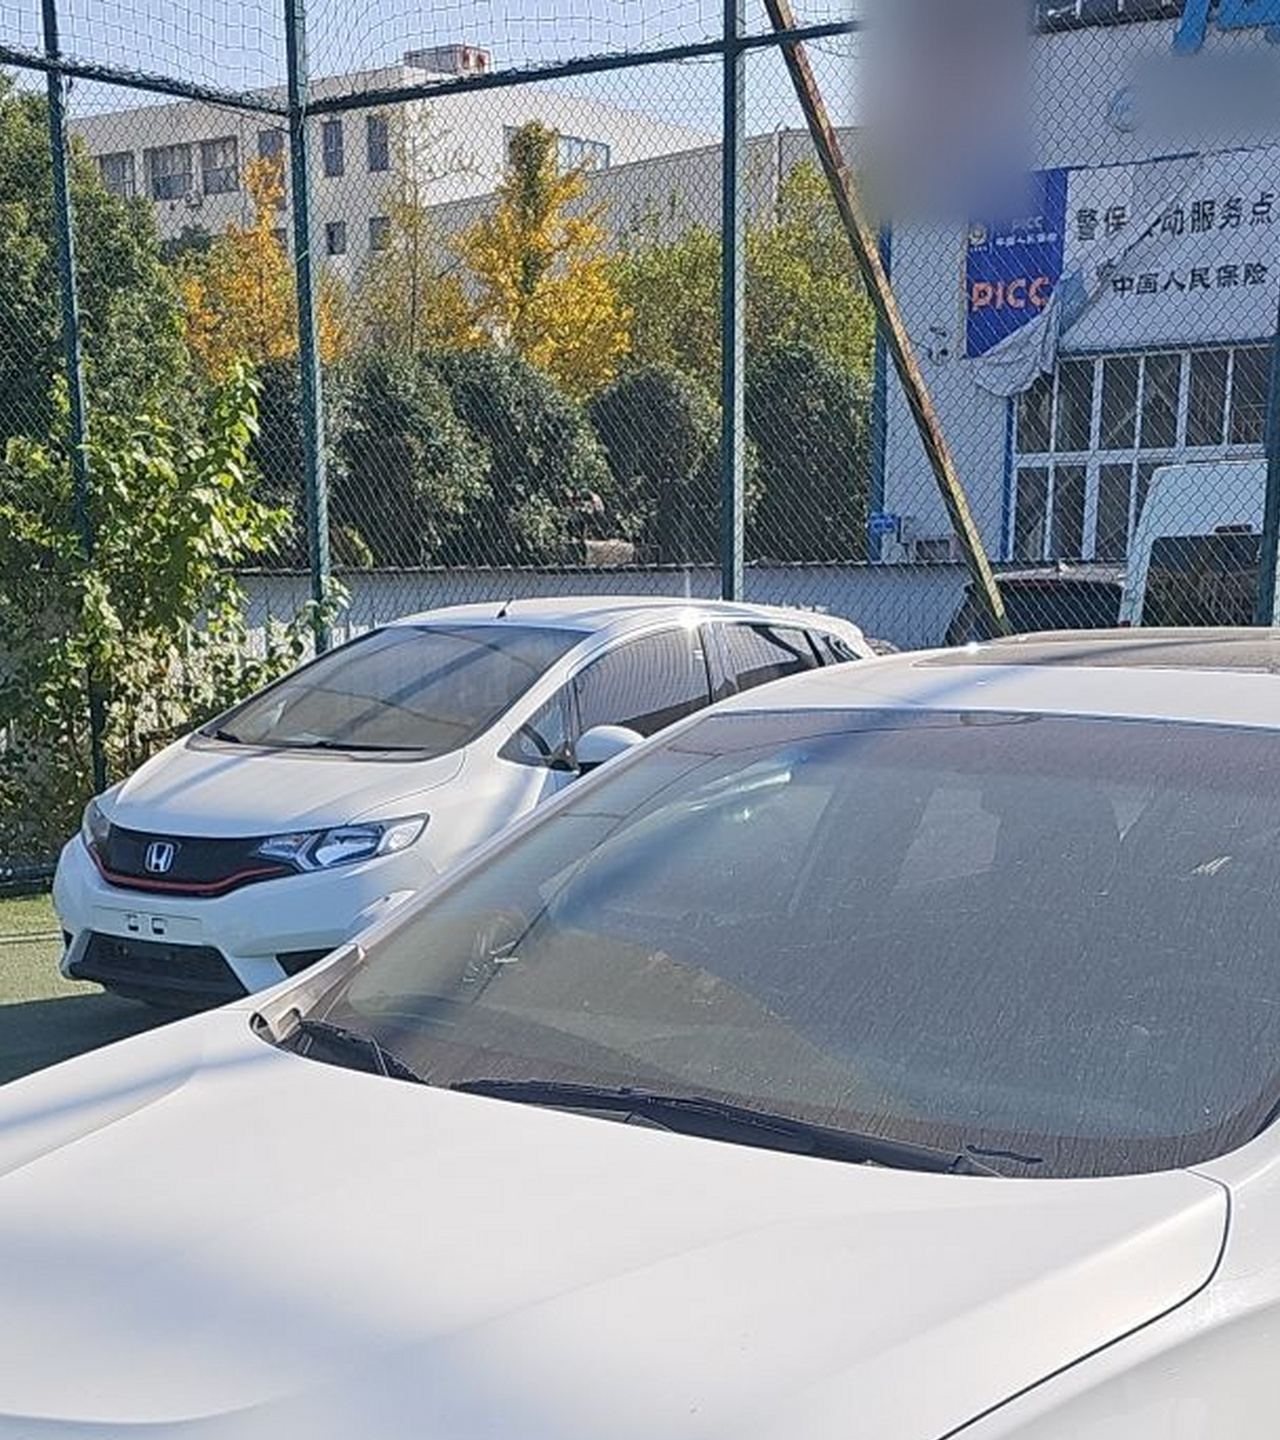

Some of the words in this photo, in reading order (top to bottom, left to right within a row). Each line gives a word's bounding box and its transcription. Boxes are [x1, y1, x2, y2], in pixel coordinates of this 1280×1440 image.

[1076, 191, 1274, 242] 警保动服务点
[972, 277, 1048, 311] PICC
[1112, 262, 1268, 296] 中国人民保险
